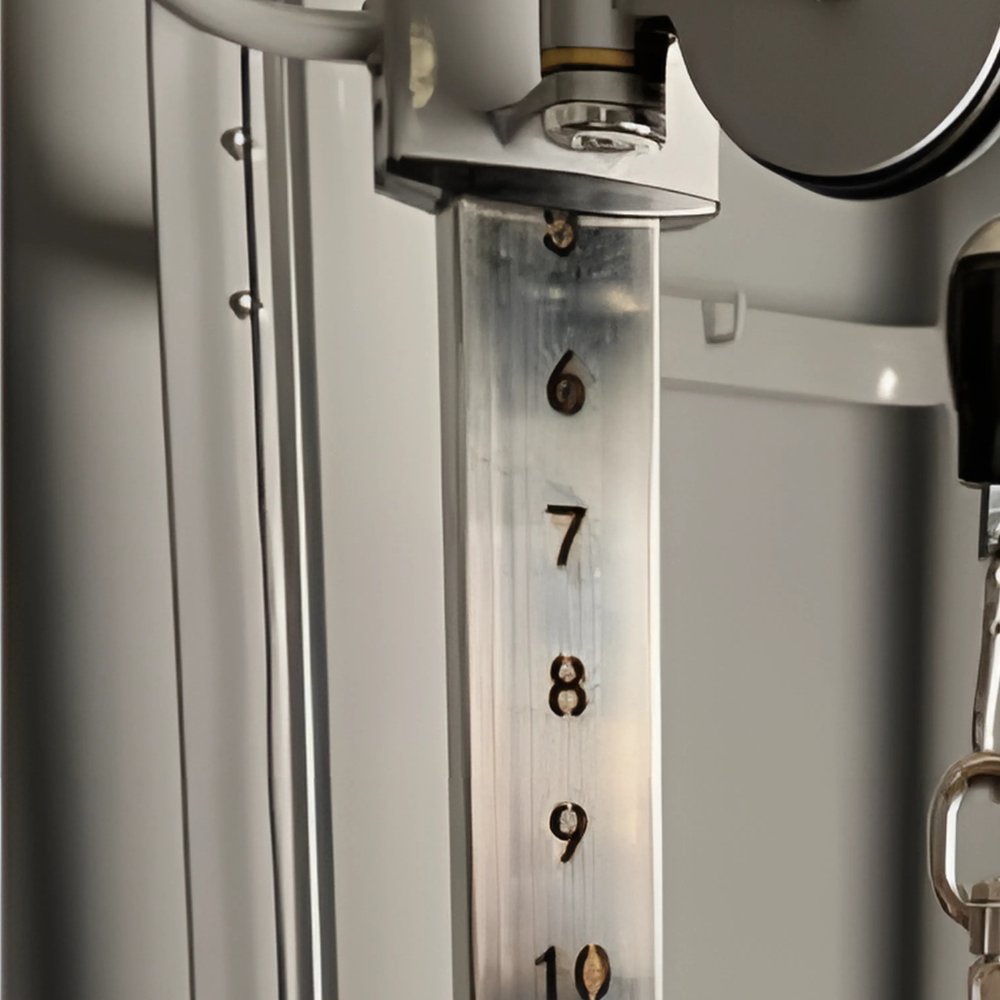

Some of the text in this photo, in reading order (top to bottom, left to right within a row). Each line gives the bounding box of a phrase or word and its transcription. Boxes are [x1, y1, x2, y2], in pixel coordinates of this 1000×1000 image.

[546, 349, 586, 416] 6
[545, 504, 588, 566] 7
[548, 654, 588, 717] 8
[549, 802, 588, 863] 9
